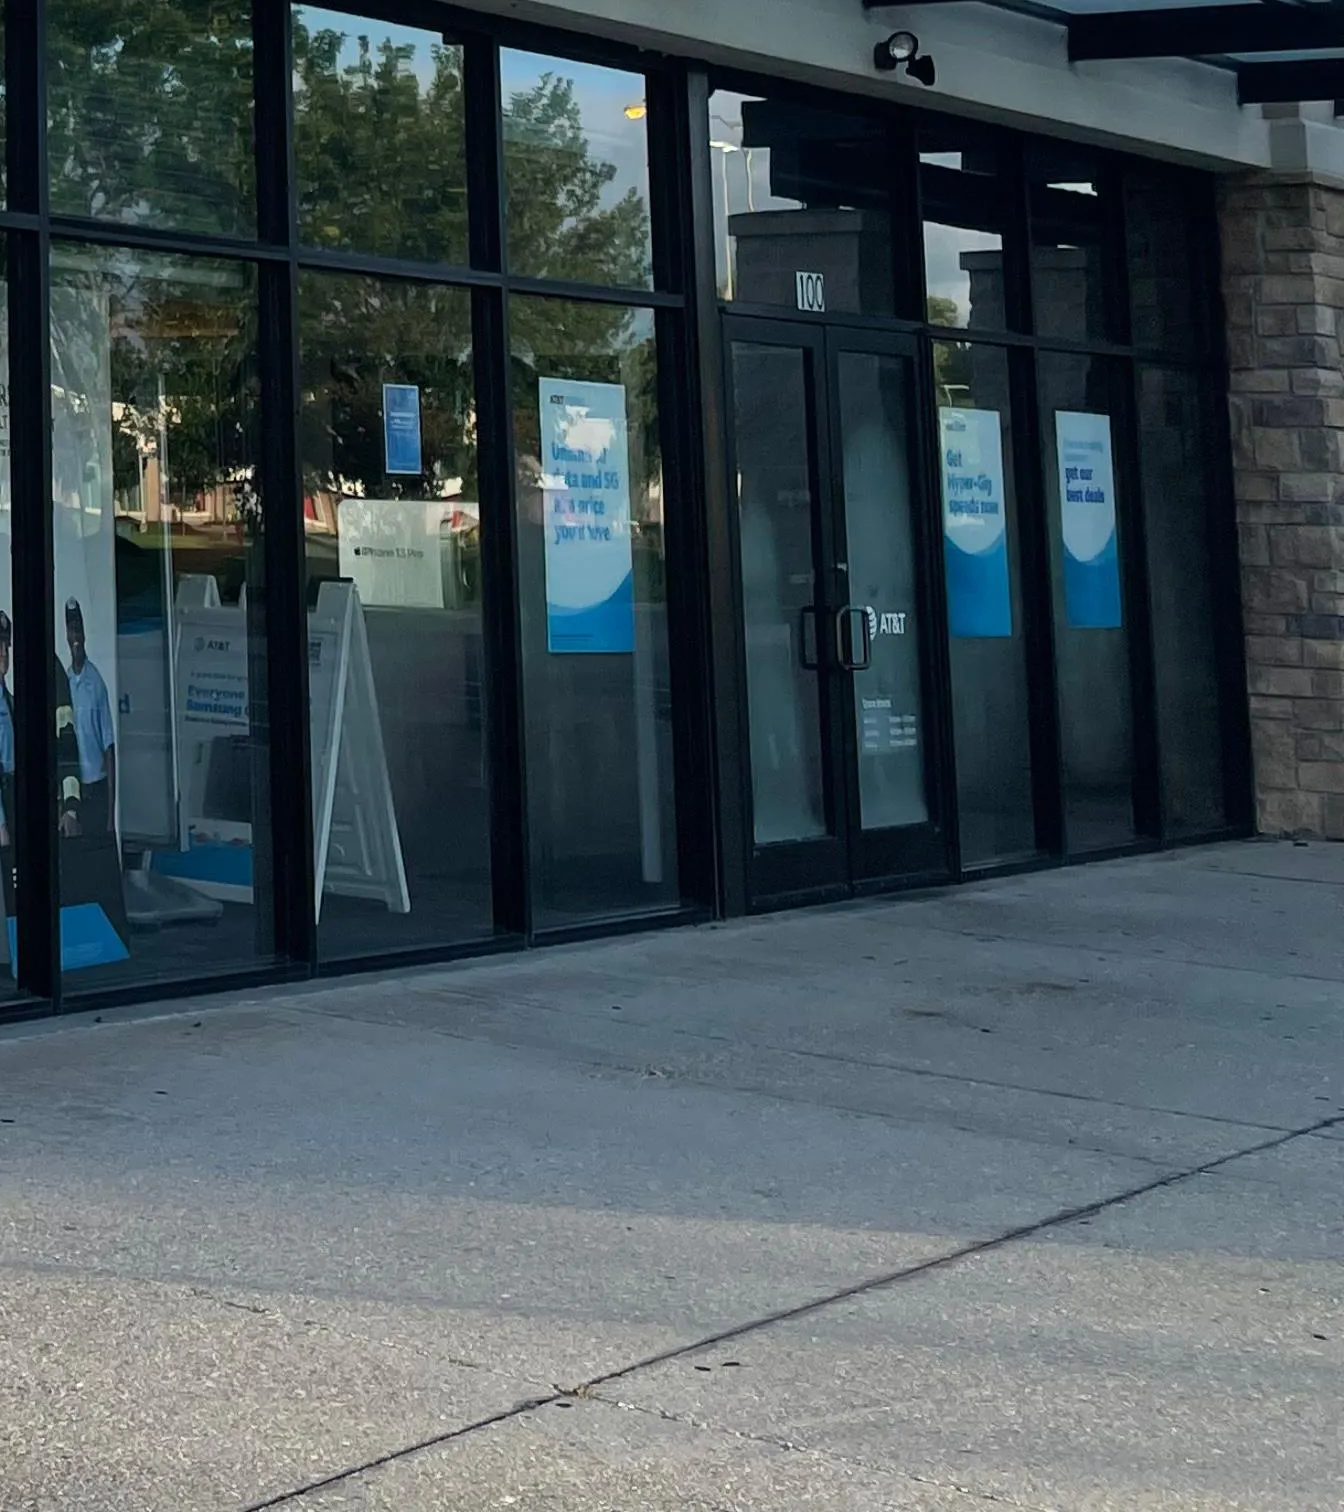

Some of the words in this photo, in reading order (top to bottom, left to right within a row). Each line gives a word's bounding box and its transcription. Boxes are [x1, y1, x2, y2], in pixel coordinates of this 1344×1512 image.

[799, 274, 824, 310] 100
[603, 471, 620, 490] 5G
[880, 612, 906, 634] AT&T
[206, 640, 231, 652] AT&T
[187, 685, 246, 701] Everyone
